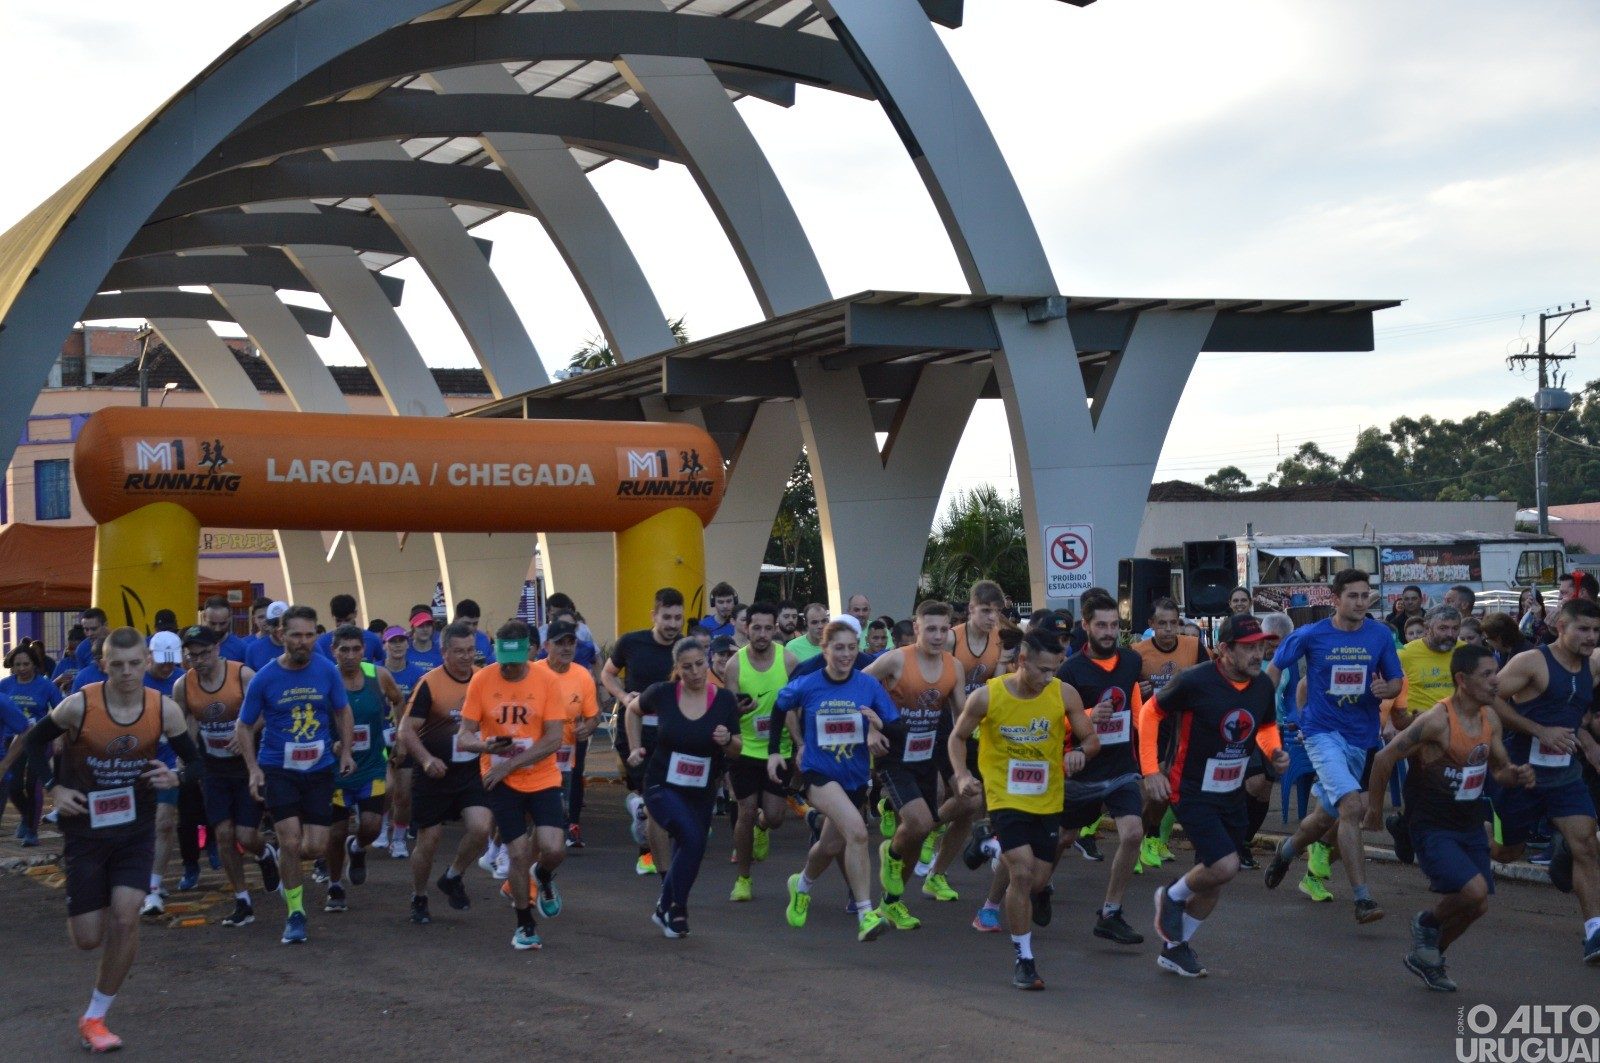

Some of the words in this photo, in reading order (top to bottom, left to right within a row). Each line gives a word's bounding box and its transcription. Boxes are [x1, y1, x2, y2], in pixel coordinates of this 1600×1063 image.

[136, 439, 185, 471] M1
[627, 449, 669, 478] M1
[266, 458, 421, 485] LARGADA
[429, 462, 438, 486] /
[448, 463, 596, 486] CHEGADA
[123, 473, 242, 492] RUNNING
[616, 480, 715, 496] RUNNING
[1048, 581, 1092, 590] ESTACIONAR
[1340, 646, 1367, 654] RÚSTICA
[1338, 673, 1362, 683] 065
[496, 705, 528, 725] JR
[900, 706, 922, 717] Med
[829, 723, 854, 733] 012
[1101, 721, 1122, 732] 059
[86, 756, 112, 768] Med
[1016, 769, 1042, 782] 070
[1443, 767, 1463, 779] Me
[99, 797, 131, 813] 056
